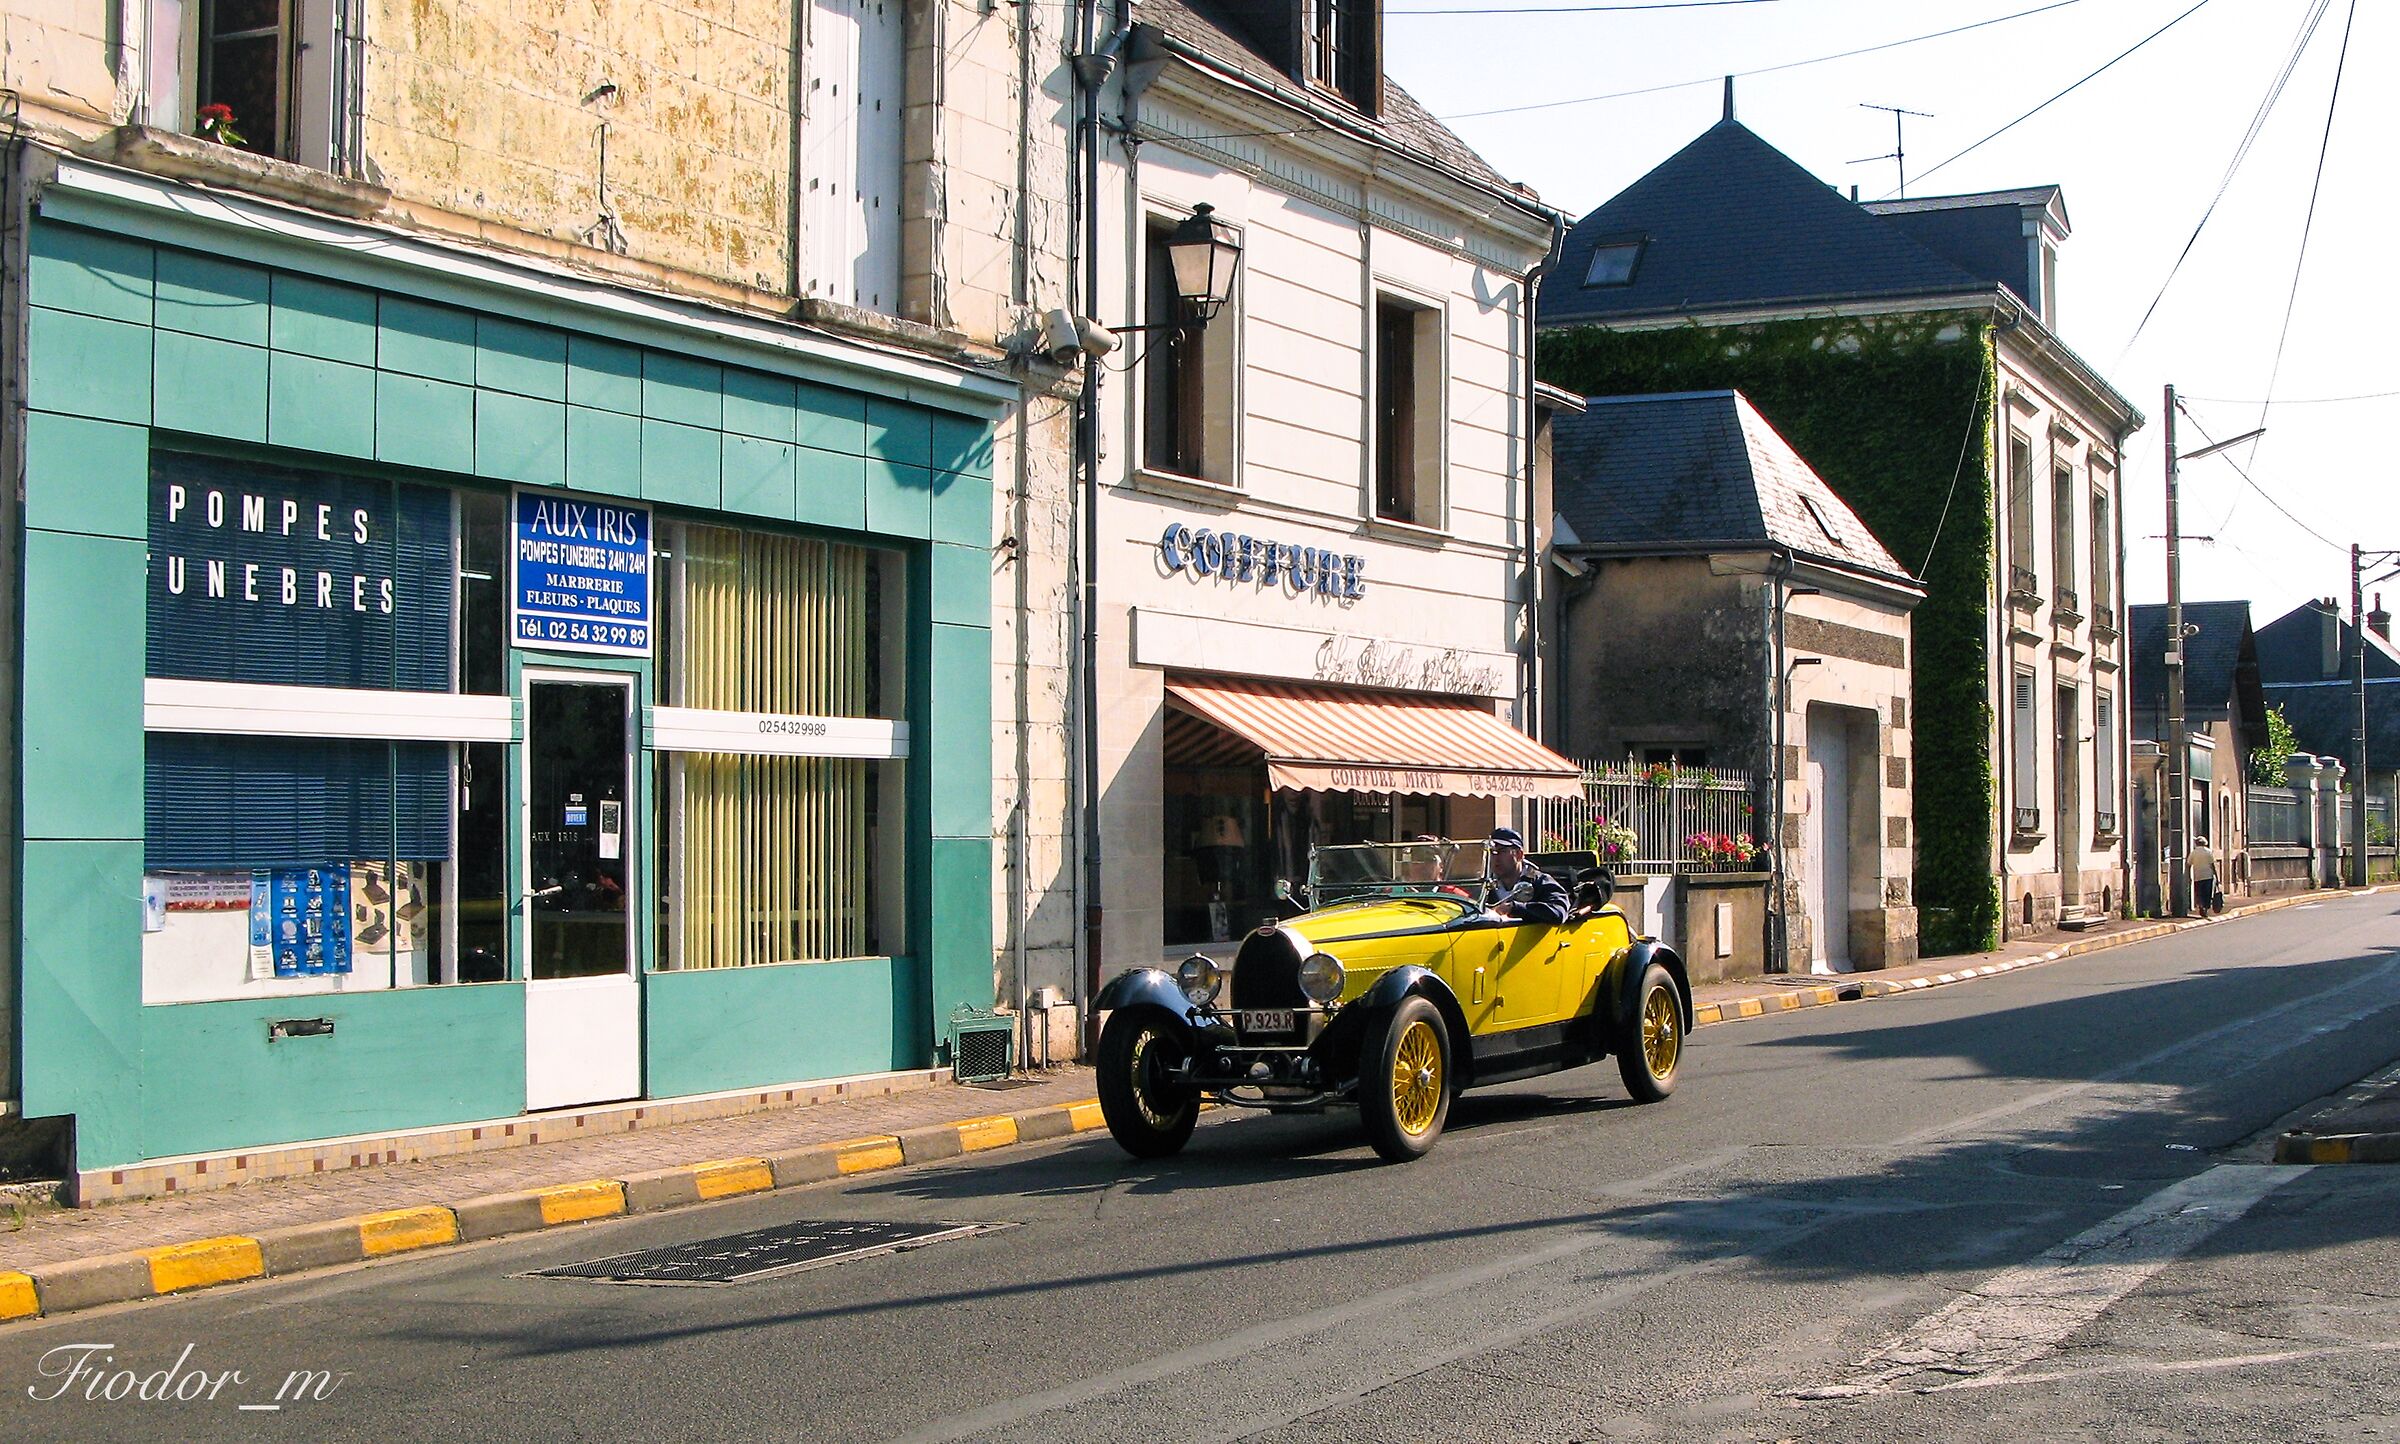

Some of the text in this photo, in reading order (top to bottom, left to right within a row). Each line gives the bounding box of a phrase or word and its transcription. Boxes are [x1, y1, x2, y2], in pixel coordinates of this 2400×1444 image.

[169, 485, 368, 544] POMPES
[531, 500, 637, 546] AUX IRIS
[520, 539, 646, 574] POMPES FUNEBRES 24H/24H
[1162, 522, 1371, 600] COIFFURE
[145, 553, 392, 613] UNEBRES
[546, 573, 624, 594] MARBRERIE
[526, 590, 578, 608] FLEURS
[586, 596, 641, 615] PLAQUES
[520, 618, 646, 645] Tél. 02 54 32 99 89
[759, 720, 826, 736] 0254329989
[1330, 769, 1397, 788] COIFFURE
[1404, 771, 1444, 789] MIXTE
[532, 832, 578, 842] AUX IRIS
[1244, 1012, 1292, 1029] P.929.R
